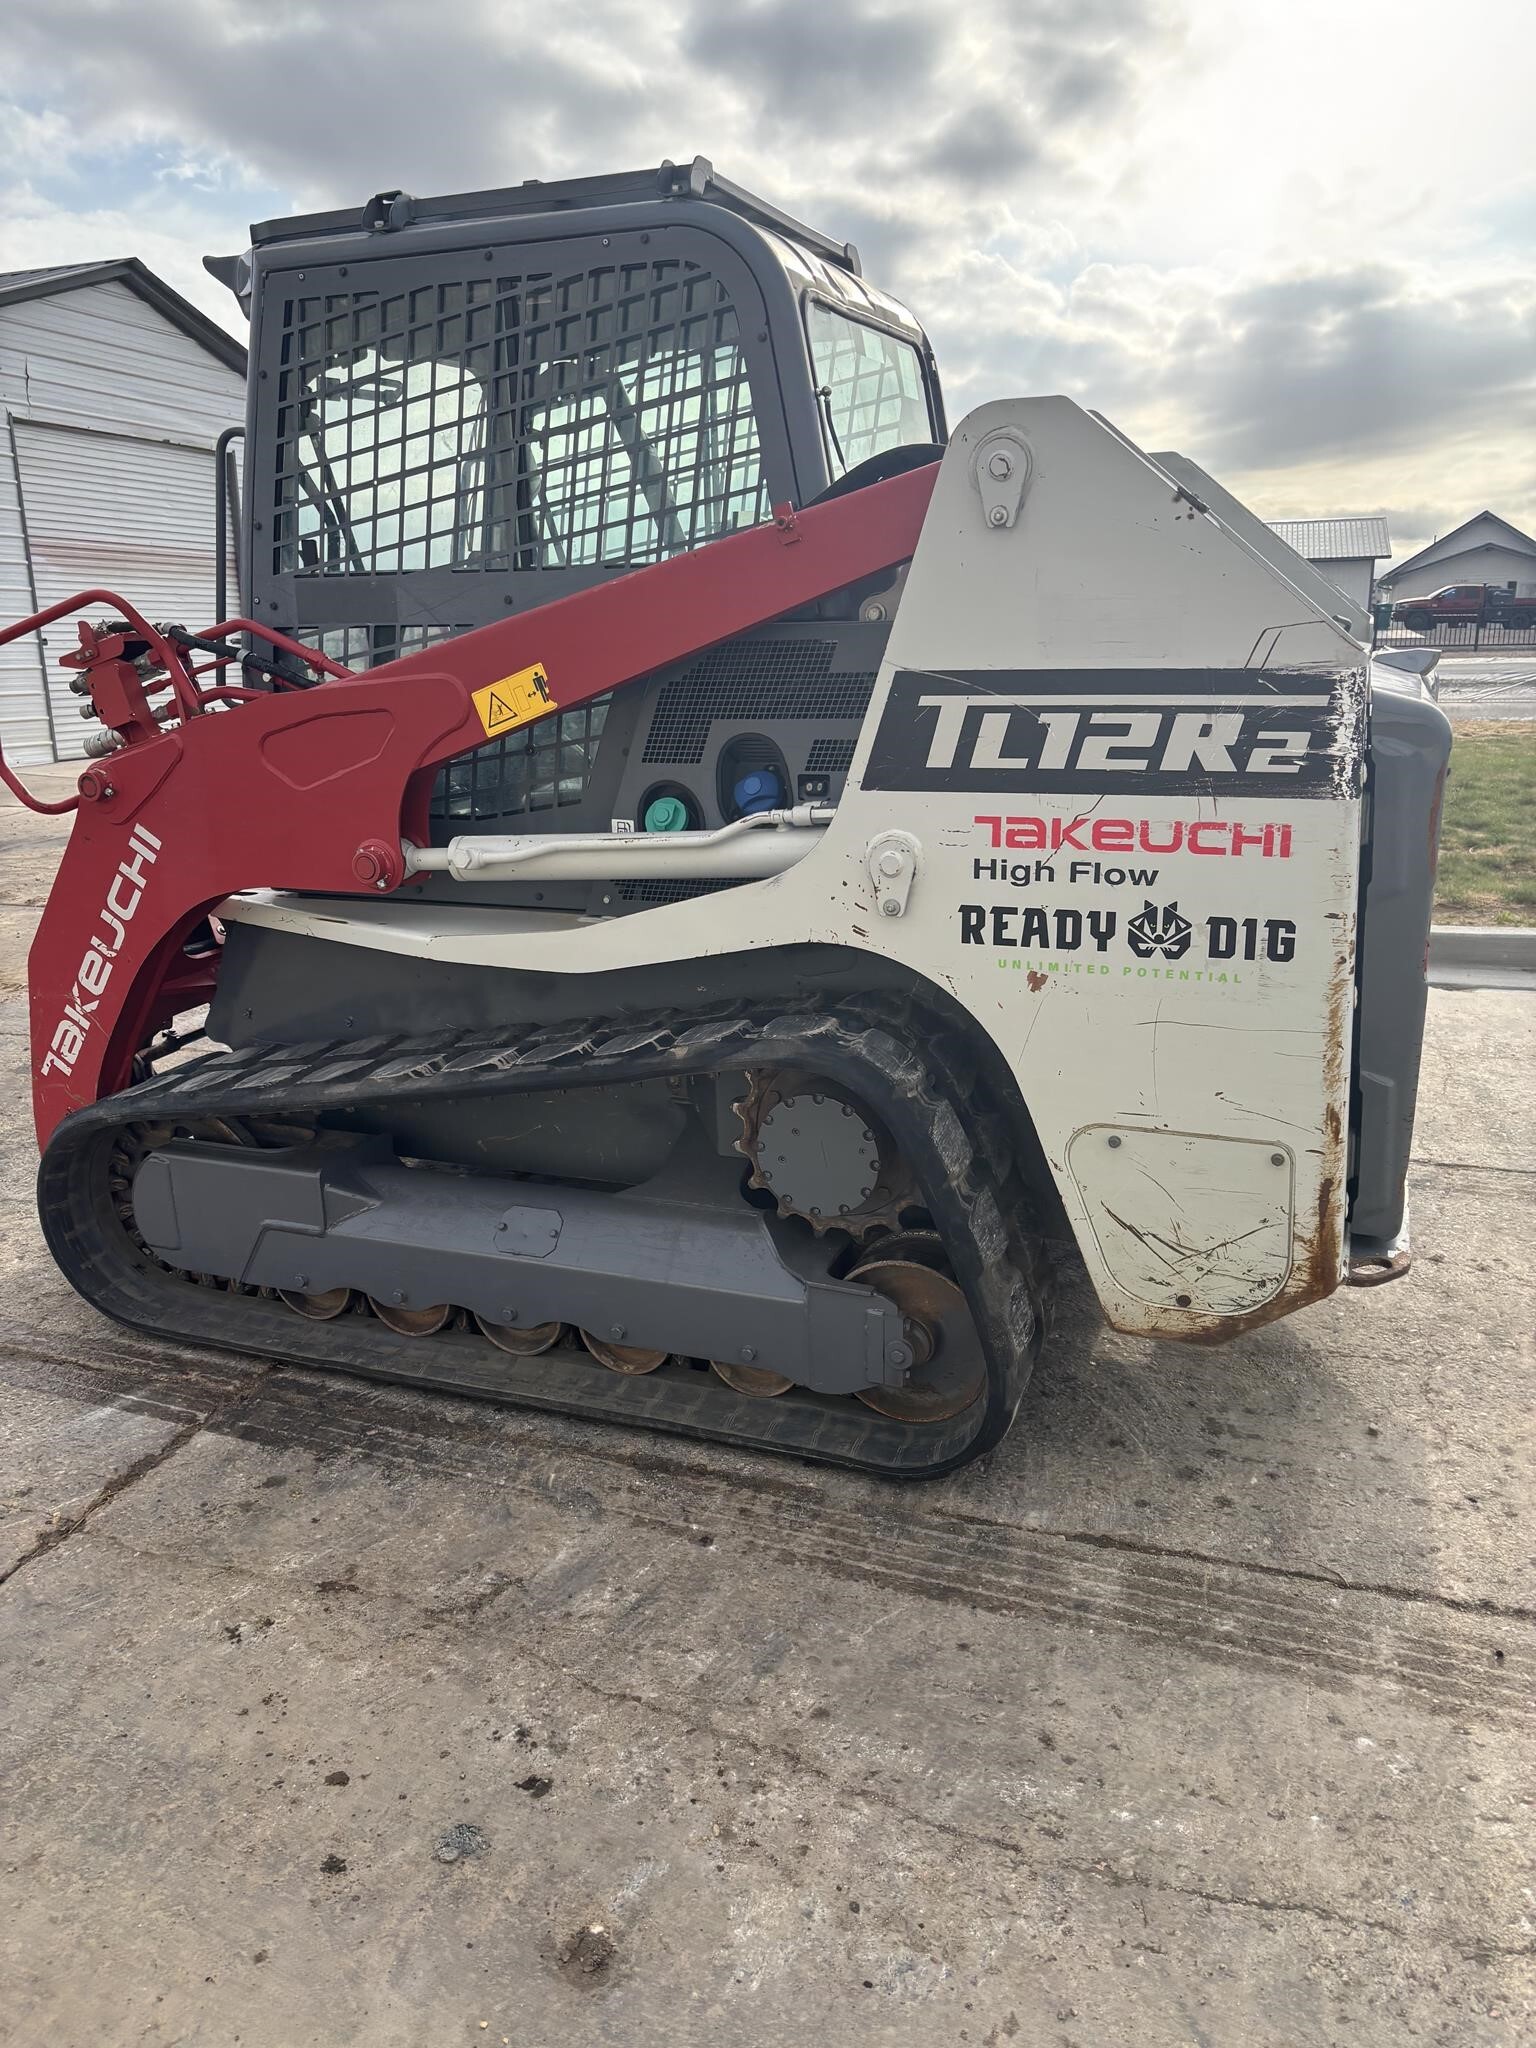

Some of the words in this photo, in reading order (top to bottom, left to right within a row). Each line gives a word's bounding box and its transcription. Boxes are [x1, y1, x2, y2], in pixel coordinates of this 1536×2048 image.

[917, 694, 1331, 775] TL12R2
[973, 858, 1055, 887] High
[1069, 861, 1160, 887] Flow
[958, 904, 1117, 952] READY
[1205, 916, 1297, 963] DIG
[997, 959, 1111, 976] UNLIMITED
[1122, 966, 1243, 984] POTENTIAL
